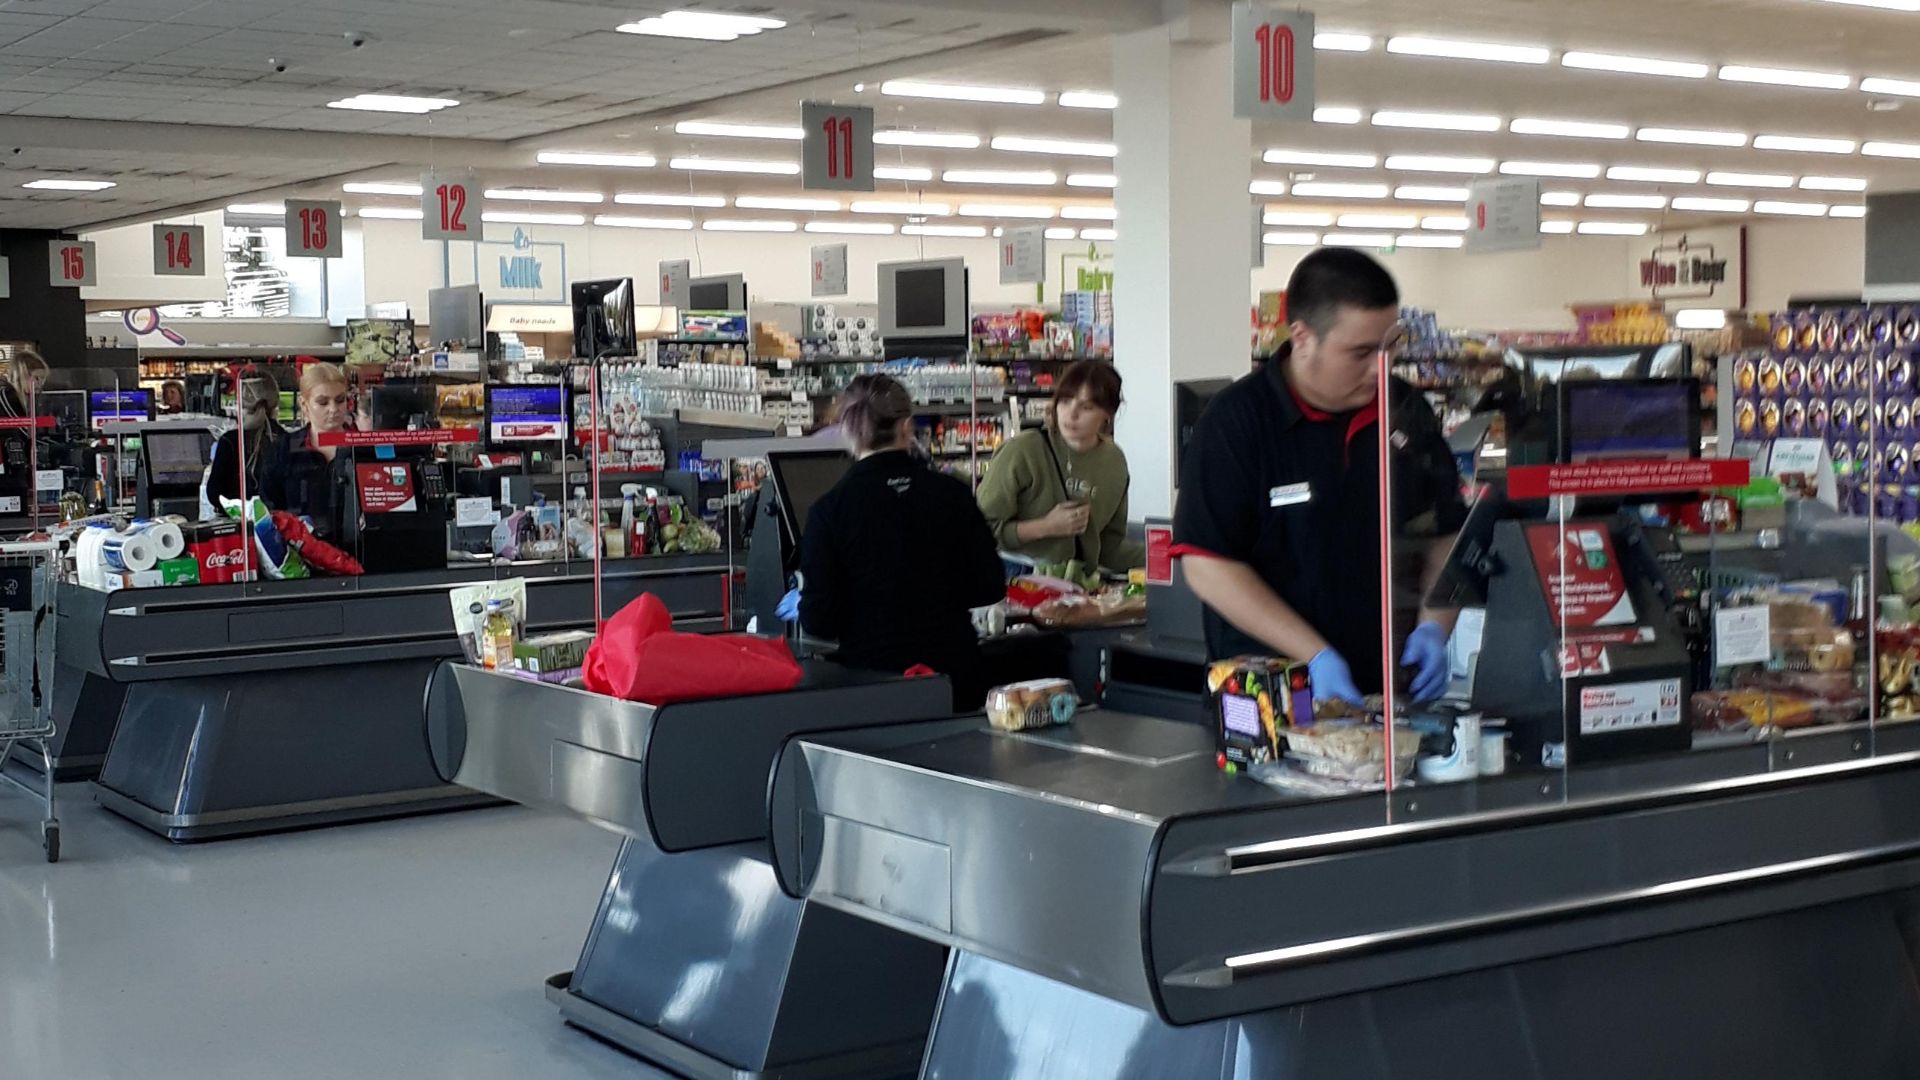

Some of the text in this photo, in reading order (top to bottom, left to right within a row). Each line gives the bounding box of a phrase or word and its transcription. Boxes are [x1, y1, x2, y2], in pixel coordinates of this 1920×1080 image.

[1255, 22, 1295, 104] 10
[823, 115, 854, 179] 11
[436, 184, 467, 232] 12
[299, 208, 328, 250] 13
[60, 247, 84, 280] 15
[164, 231, 192, 268] 14
[1006, 243, 1013, 266] 11
[499, 255, 543, 289] Milk
[1640, 258, 1676, 287] Wine
[1692, 256, 1727, 283] Beer
[509, 316, 530, 326] Baby
